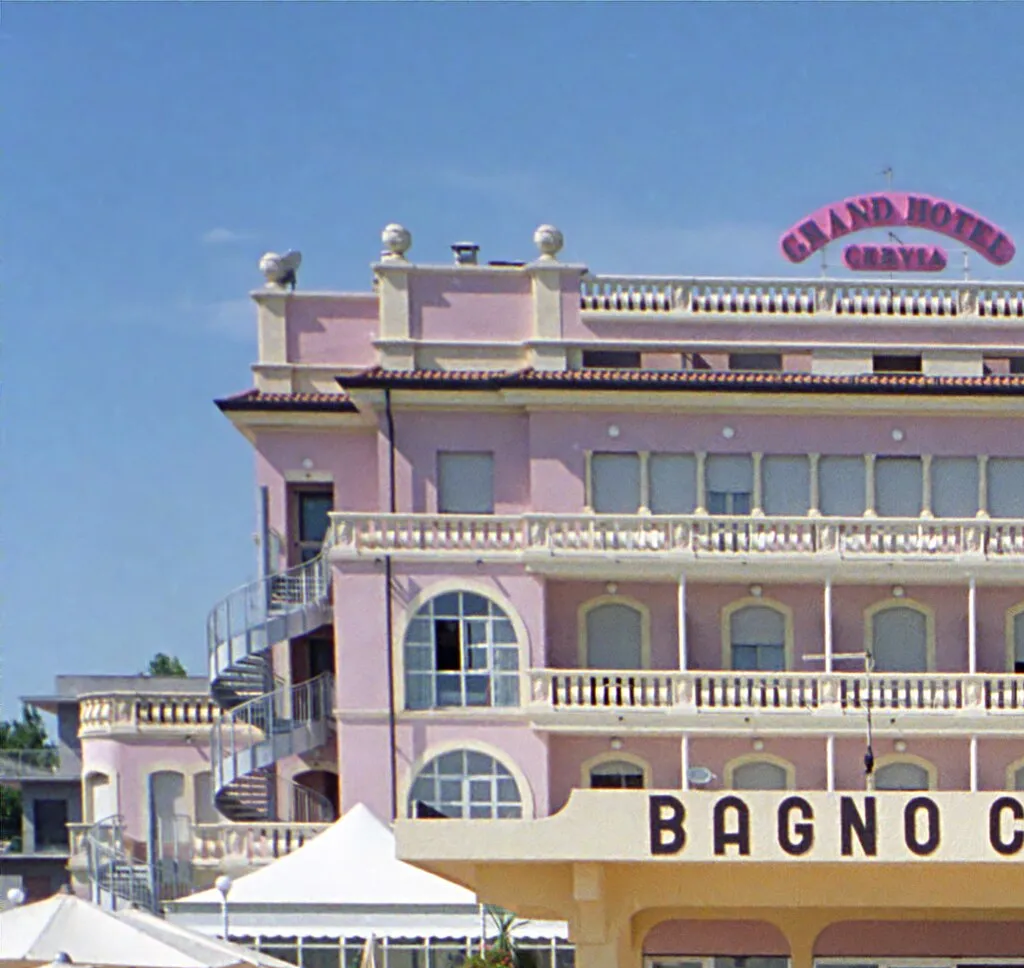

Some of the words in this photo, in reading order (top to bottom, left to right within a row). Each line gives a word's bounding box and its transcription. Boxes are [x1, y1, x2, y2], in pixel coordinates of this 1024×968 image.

[781, 196, 894, 260] GRAND
[906, 196, 1010, 262] HOTEL
[844, 245, 947, 267] CERVIA
[649, 795, 941, 856] BAGNO
